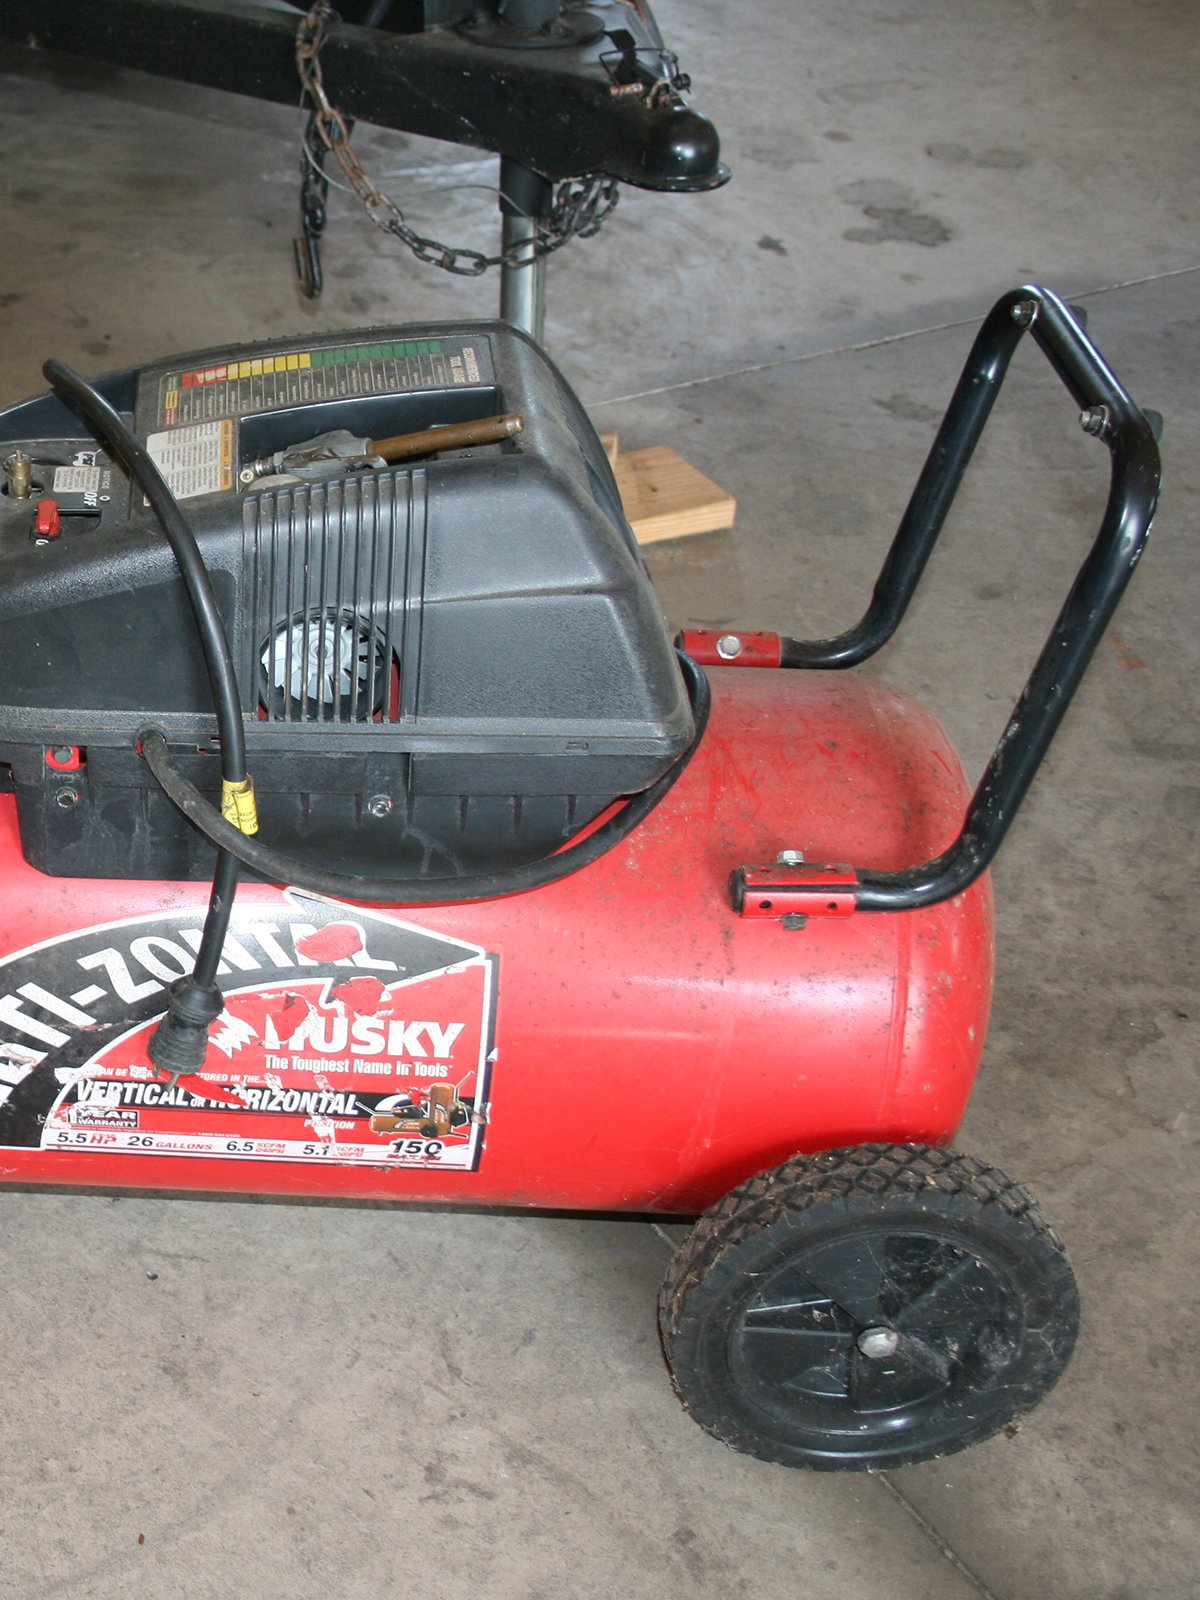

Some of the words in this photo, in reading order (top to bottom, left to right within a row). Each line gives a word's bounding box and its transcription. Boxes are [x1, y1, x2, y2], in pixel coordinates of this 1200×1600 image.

[84, 492, 97, 506] OFF
[264, 1054, 289, 1070] The
[291, 1055, 350, 1074] Toughest
[353, 1058, 392, 1075] Name
[413, 1061, 449, 1078] Tools
[114, 1067, 129, 1078] BE
[229, 1073, 242, 1083] IN
[77, 1079, 189, 1108] VERTICAL
[78, 1118, 137, 1127] WARRANTY
[57, 1132, 87, 1144] 5.5
[127, 1135, 154, 1147] 26
[155, 1141, 213, 1151] GALLONS
[226, 1140, 254, 1152] 6.5
[302, 1144, 330, 1156] 5.1
[392, 1140, 443, 1156] 150
